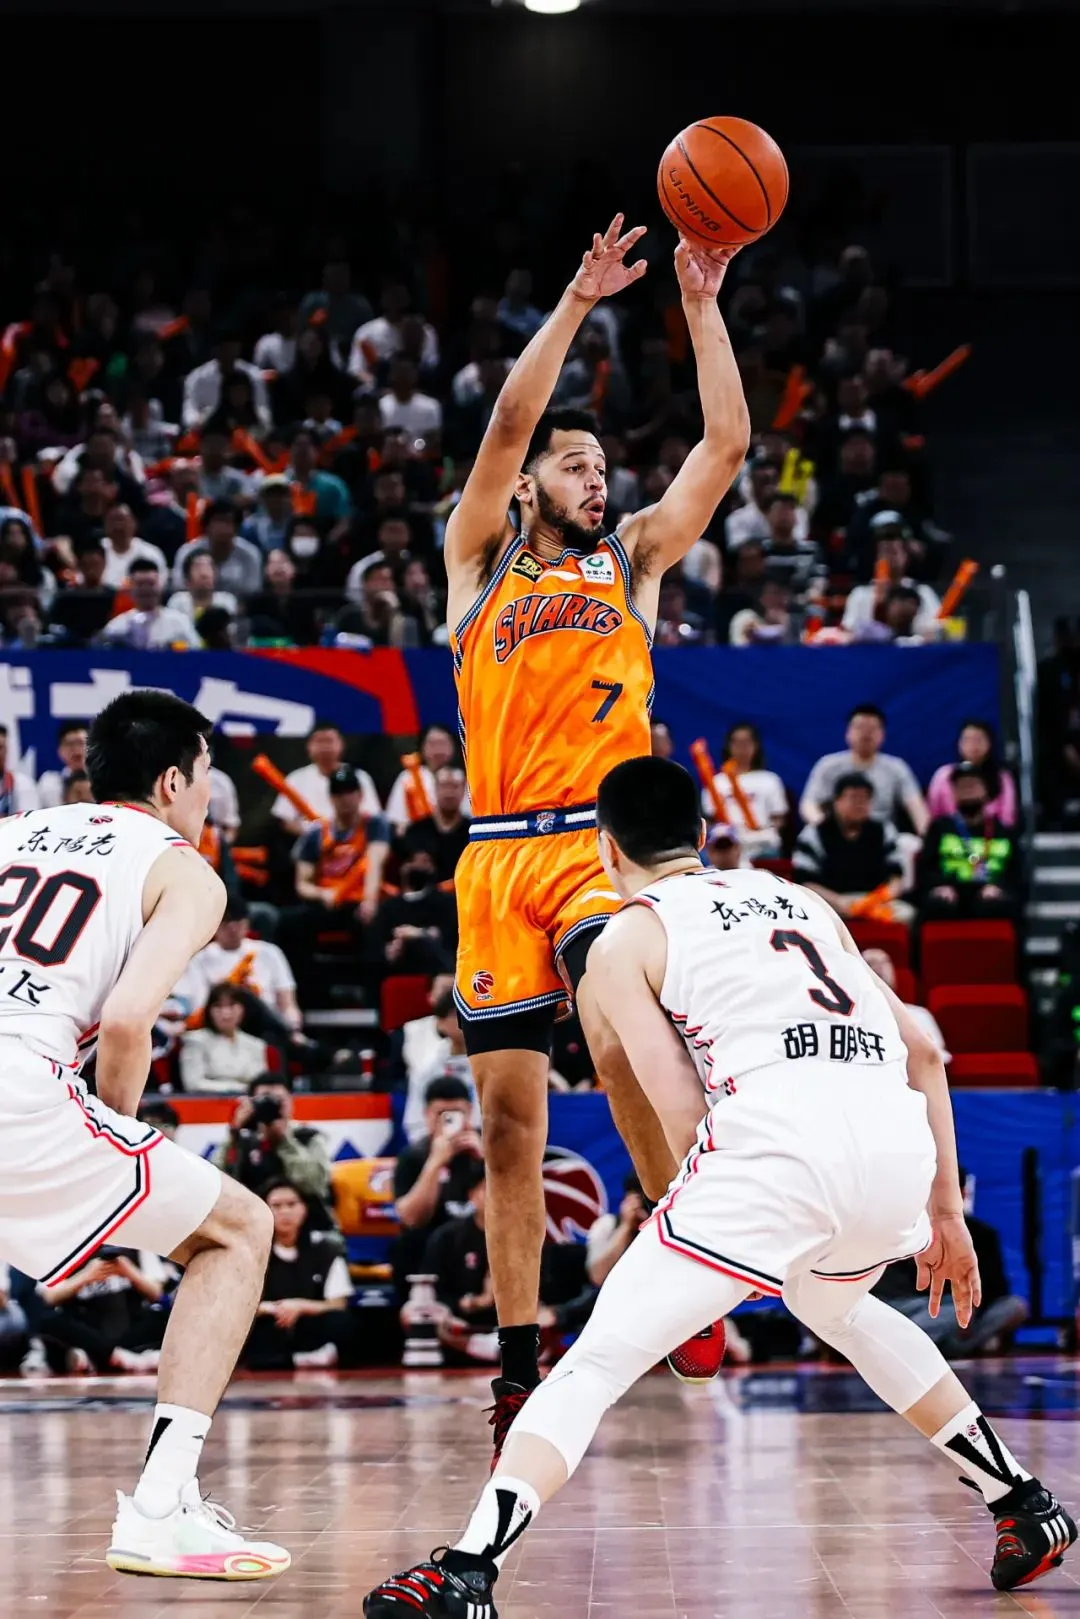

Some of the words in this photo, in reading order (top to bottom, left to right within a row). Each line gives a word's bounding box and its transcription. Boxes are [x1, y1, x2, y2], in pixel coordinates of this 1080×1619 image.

[669, 168, 721, 232] LI-NING
[493, 591, 623, 664] SHARKS
[591, 680, 623, 723] 7
[769, 929, 855, 1016] 3
[780, 1023, 886, 1063] 胡明轩
